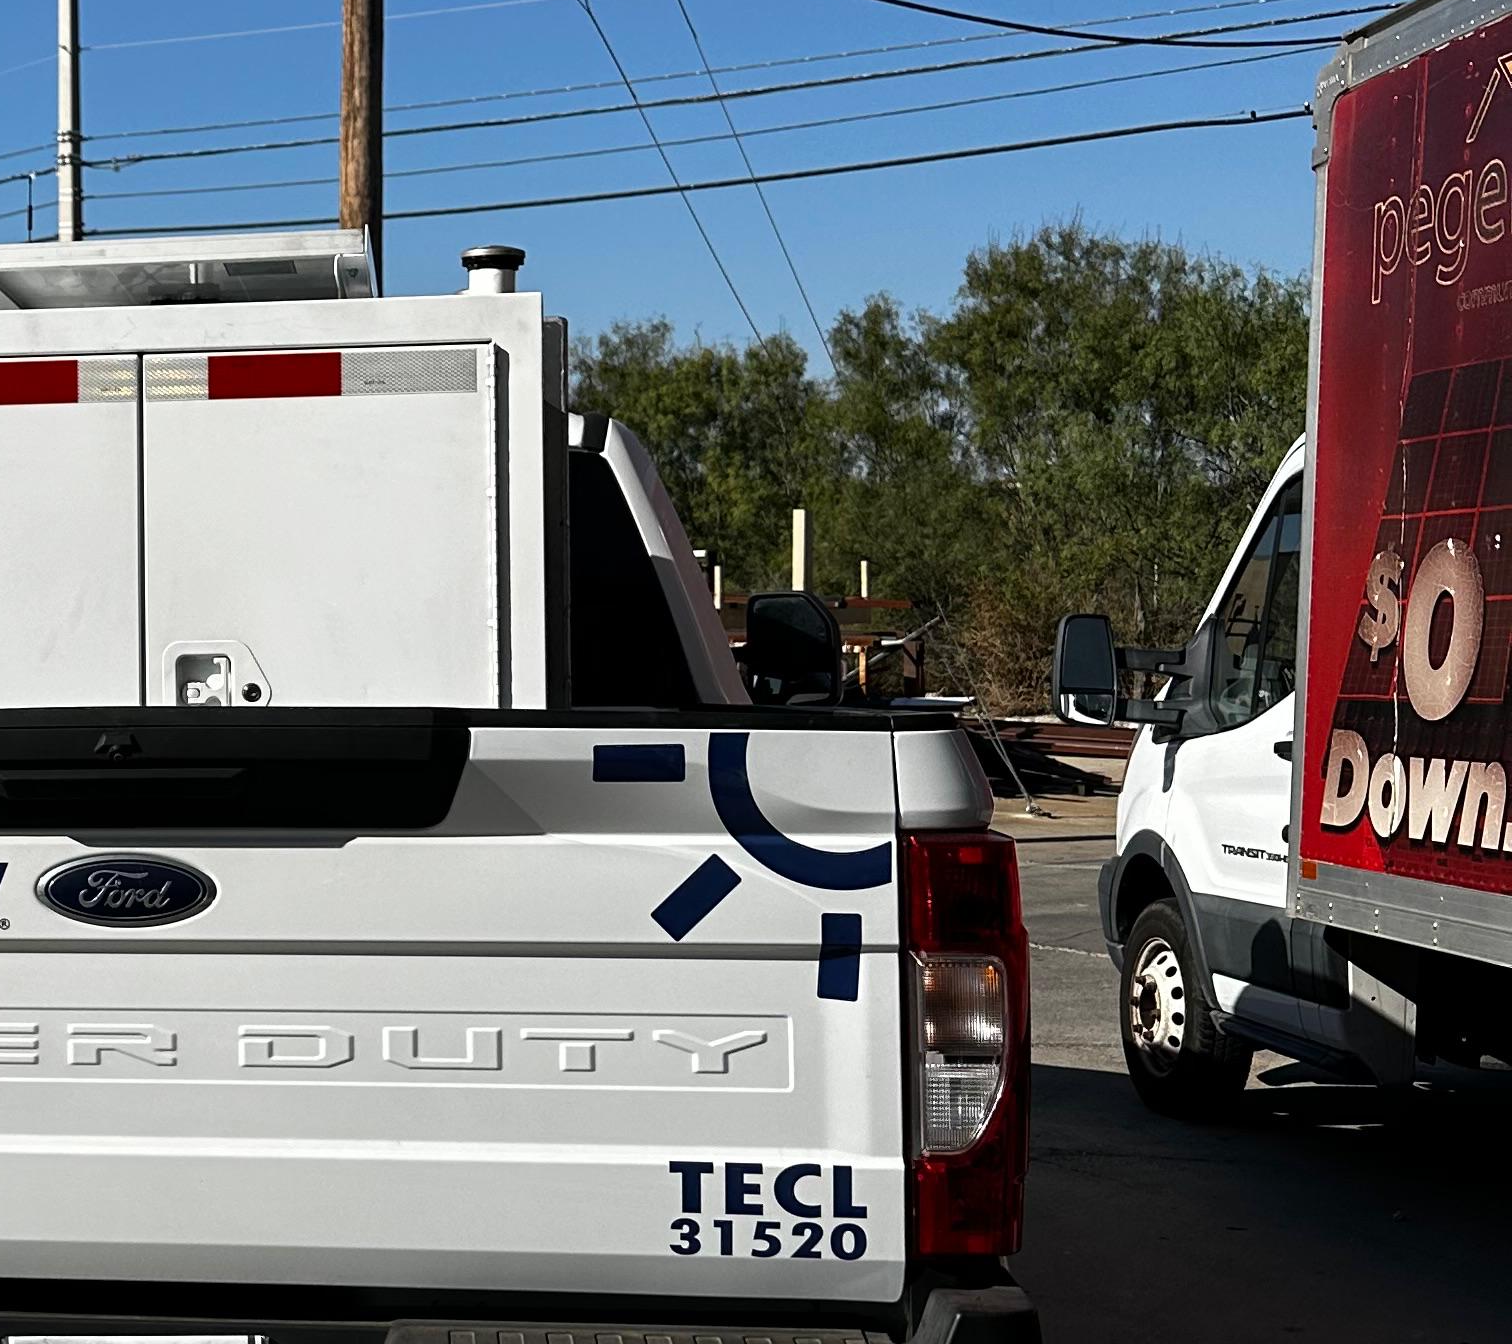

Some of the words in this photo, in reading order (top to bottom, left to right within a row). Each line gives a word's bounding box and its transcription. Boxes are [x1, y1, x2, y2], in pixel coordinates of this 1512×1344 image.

[1371, 158, 1512, 304] pege
[1221, 844, 1266, 860] TRANSIT
[78, 869, 172, 909] Ford
[237, 1023, 768, 1076] DUTY
[669, 1160, 869, 1220] TECL
[669, 1219, 869, 1261] 31520
